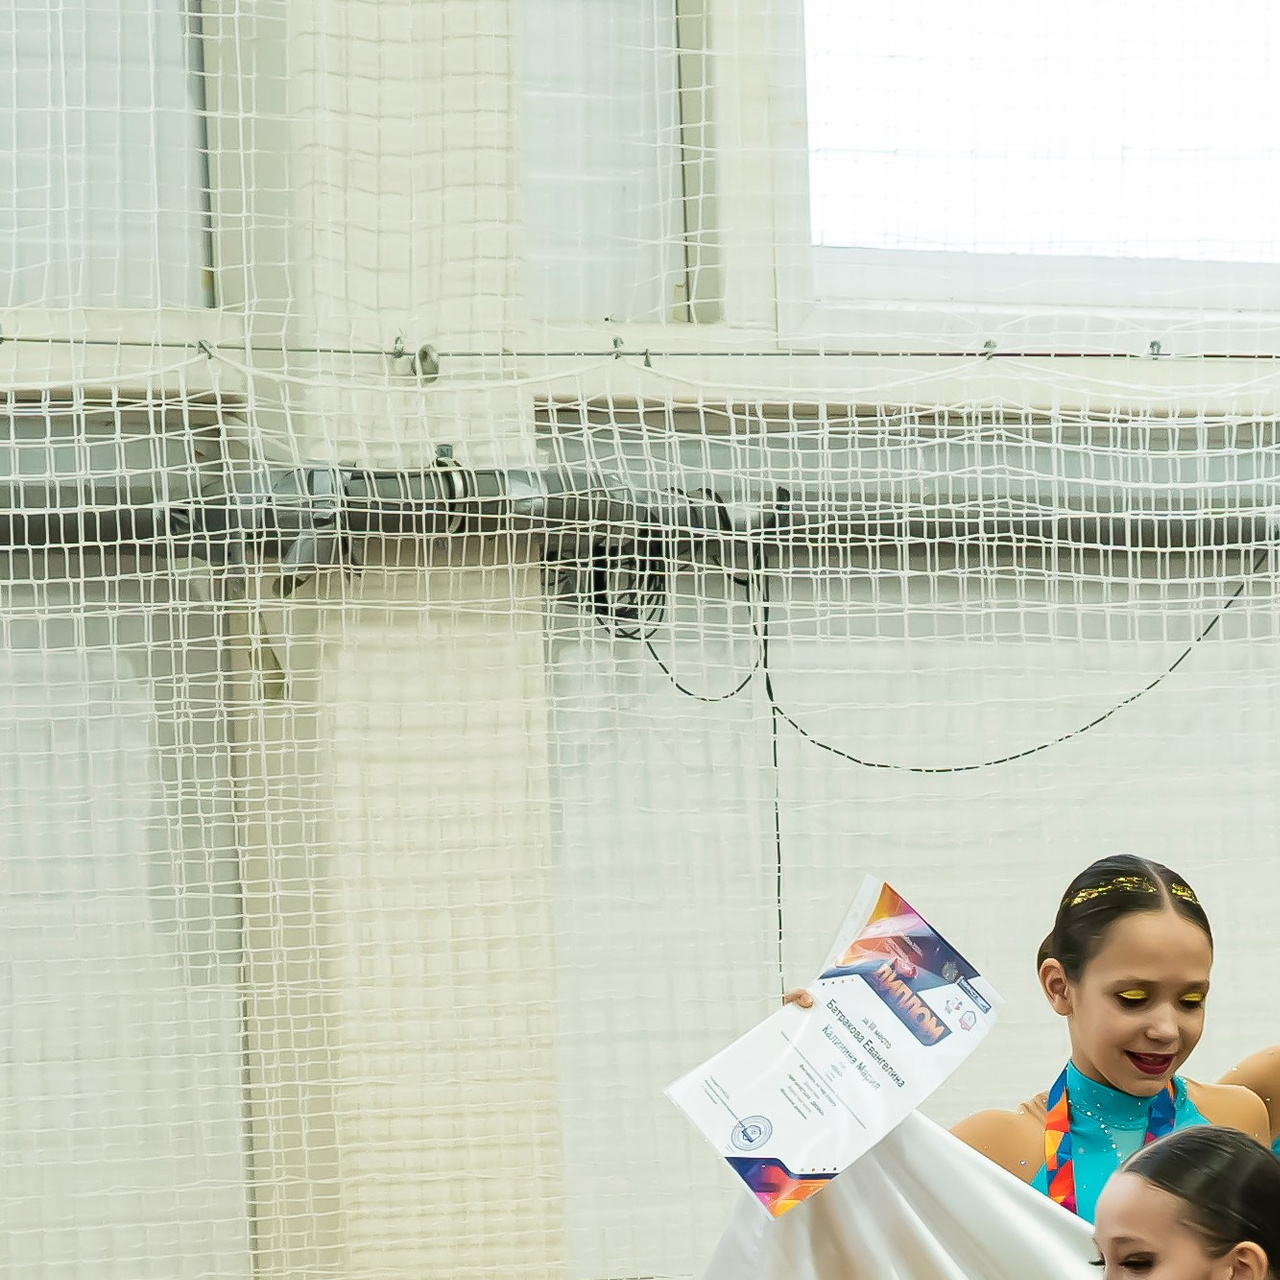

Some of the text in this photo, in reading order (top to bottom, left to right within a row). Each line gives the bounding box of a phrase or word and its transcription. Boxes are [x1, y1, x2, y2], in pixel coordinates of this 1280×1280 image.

[825, 998, 905, 1088] Батракова Евангелина
[873, 963, 944, 1042] ДИПЛОМ
